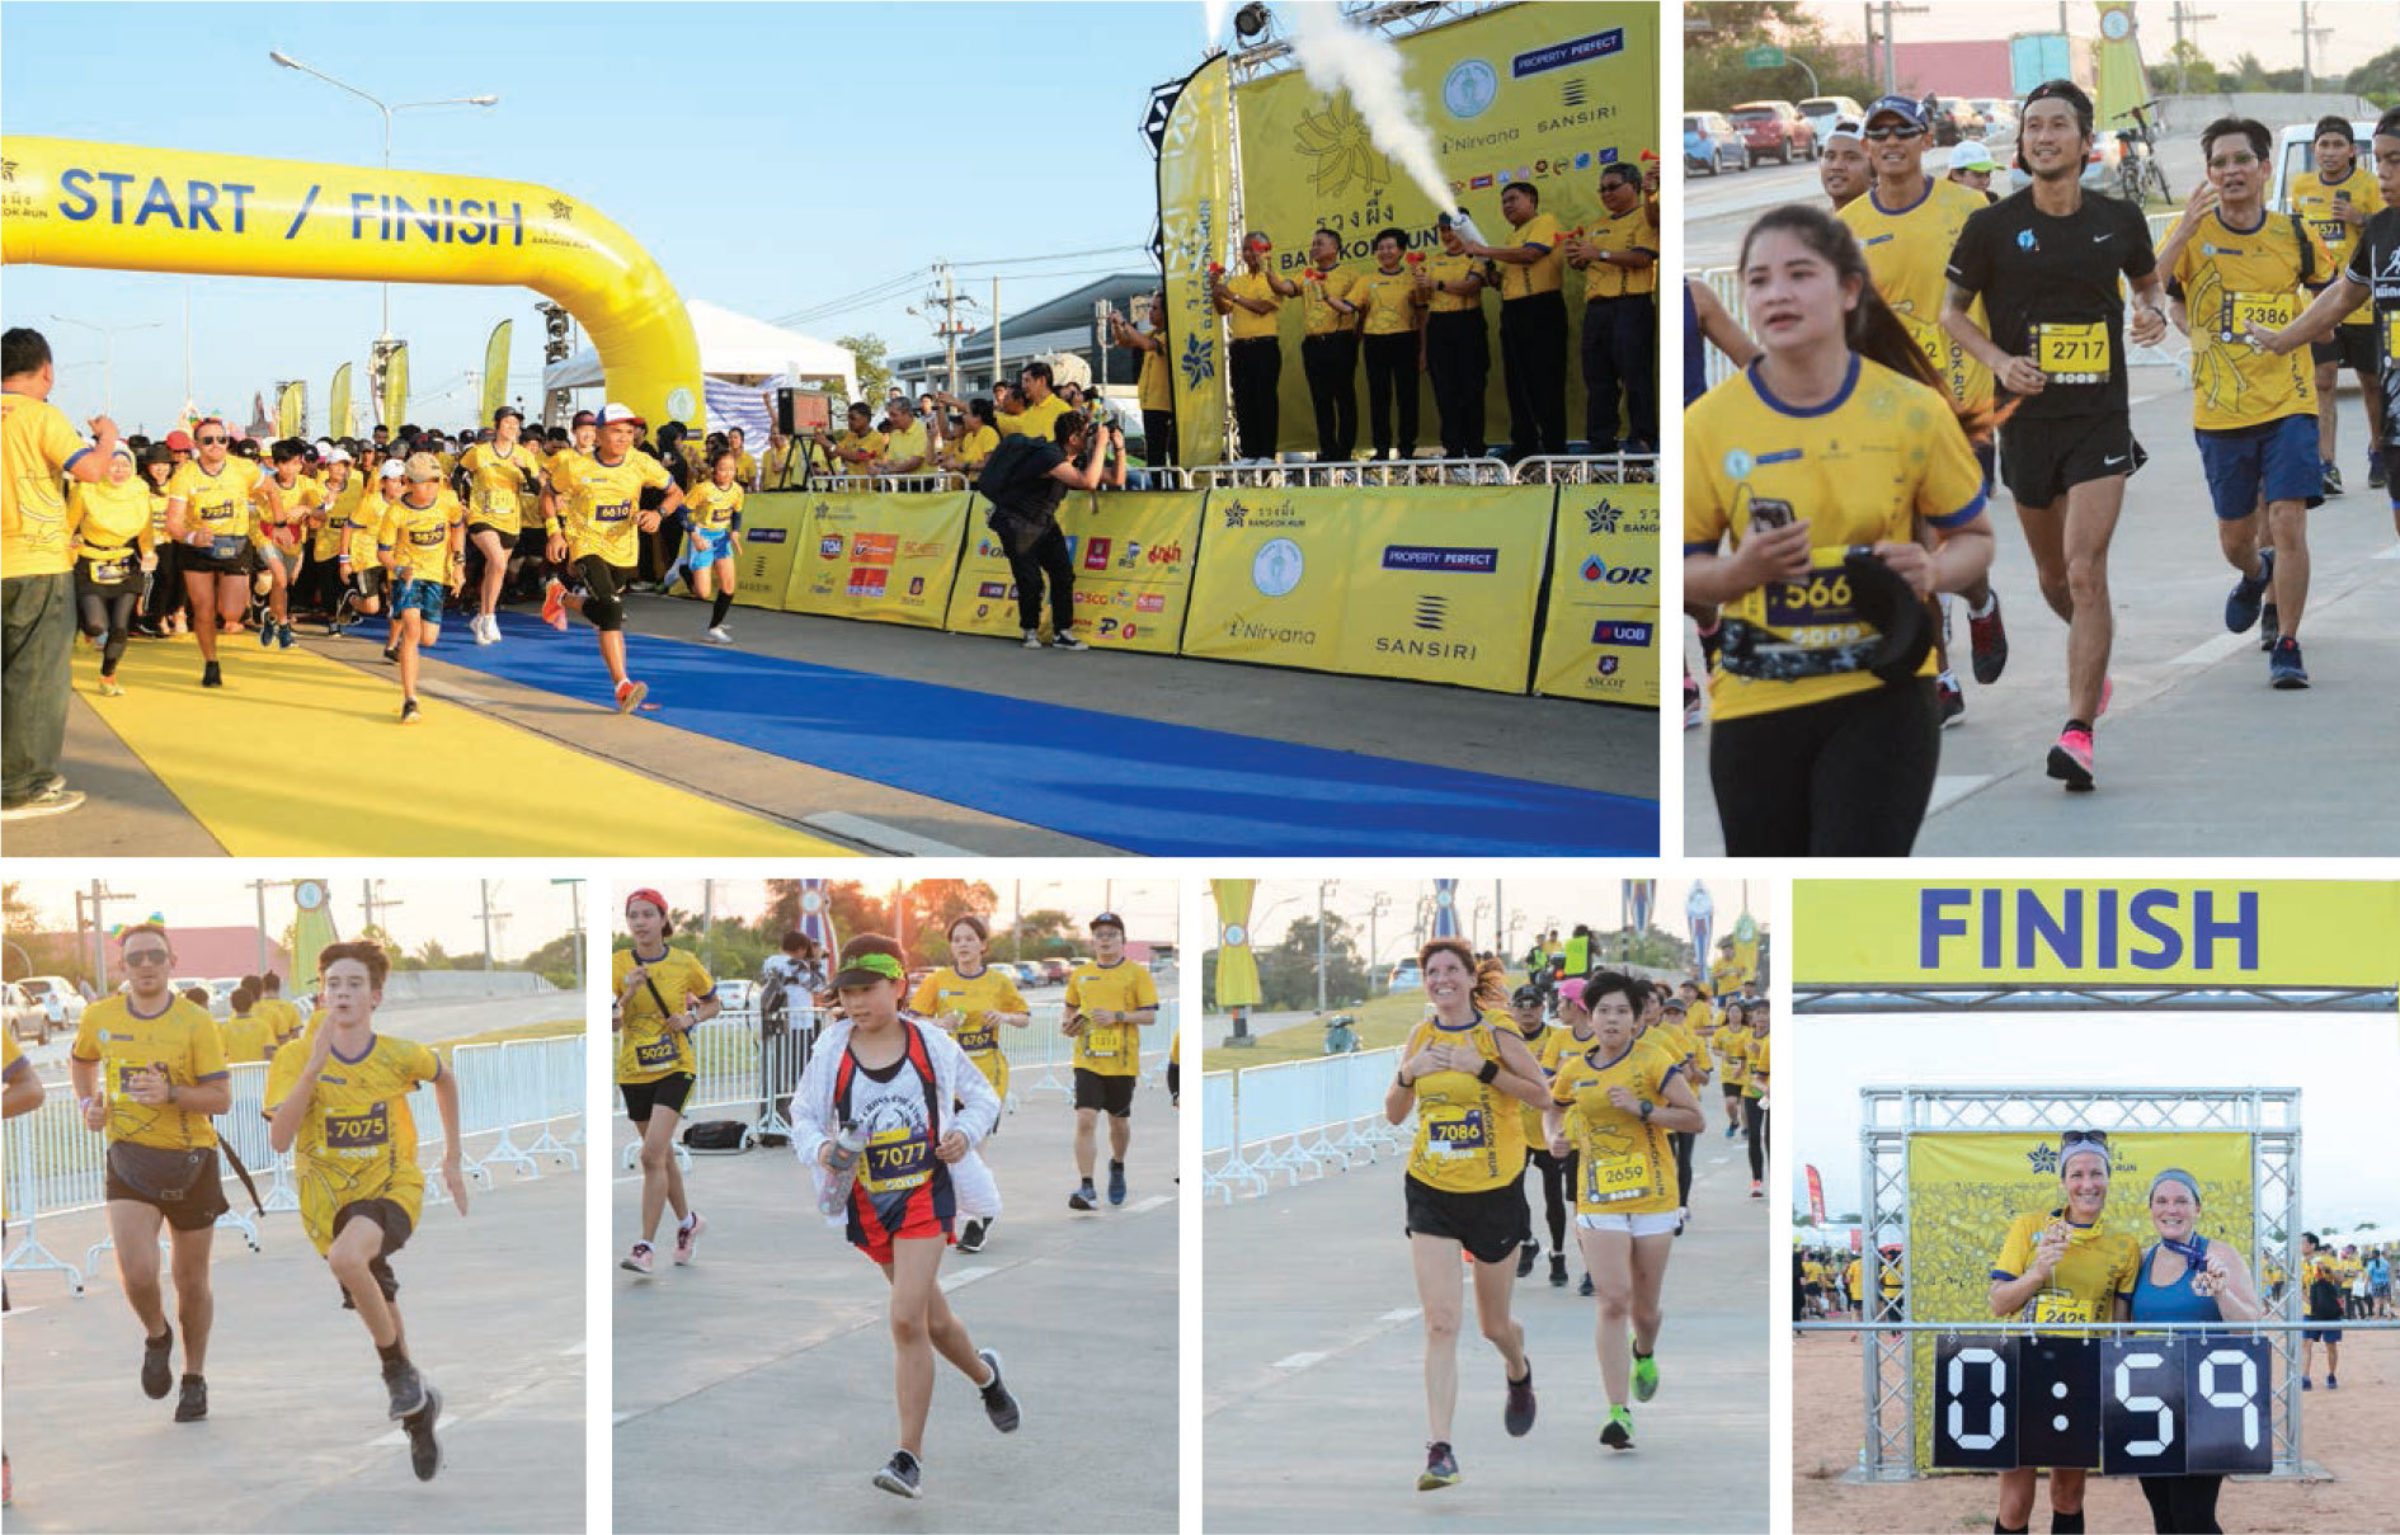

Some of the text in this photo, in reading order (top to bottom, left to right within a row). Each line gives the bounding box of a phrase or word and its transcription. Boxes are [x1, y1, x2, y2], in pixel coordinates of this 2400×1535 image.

[1518, 35, 1619, 69] PROPERTY PERFECT
[1537, 105, 1617, 133] SANSIRI
[59, 168, 254, 235] START
[351, 193, 524, 246] FINISH
[2244, 306, 2289, 326] 2386
[2053, 340, 2105, 360] 2717
[1389, 550, 1491, 565] PROPERTY PERFECT
[1606, 566, 1653, 585] OR
[1243, 623, 1317, 645] Nirvana
[1614, 627, 1645, 640] UOB
[1376, 637, 1477, 660] SANSIRI
[1919, 888, 2259, 970] FINISH
[335, 1117, 385, 1138] 7075
[1436, 1123, 1479, 1141] 7086
[875, 1141, 926, 1168] 7077
[1605, 1165, 1643, 1184] 2659
